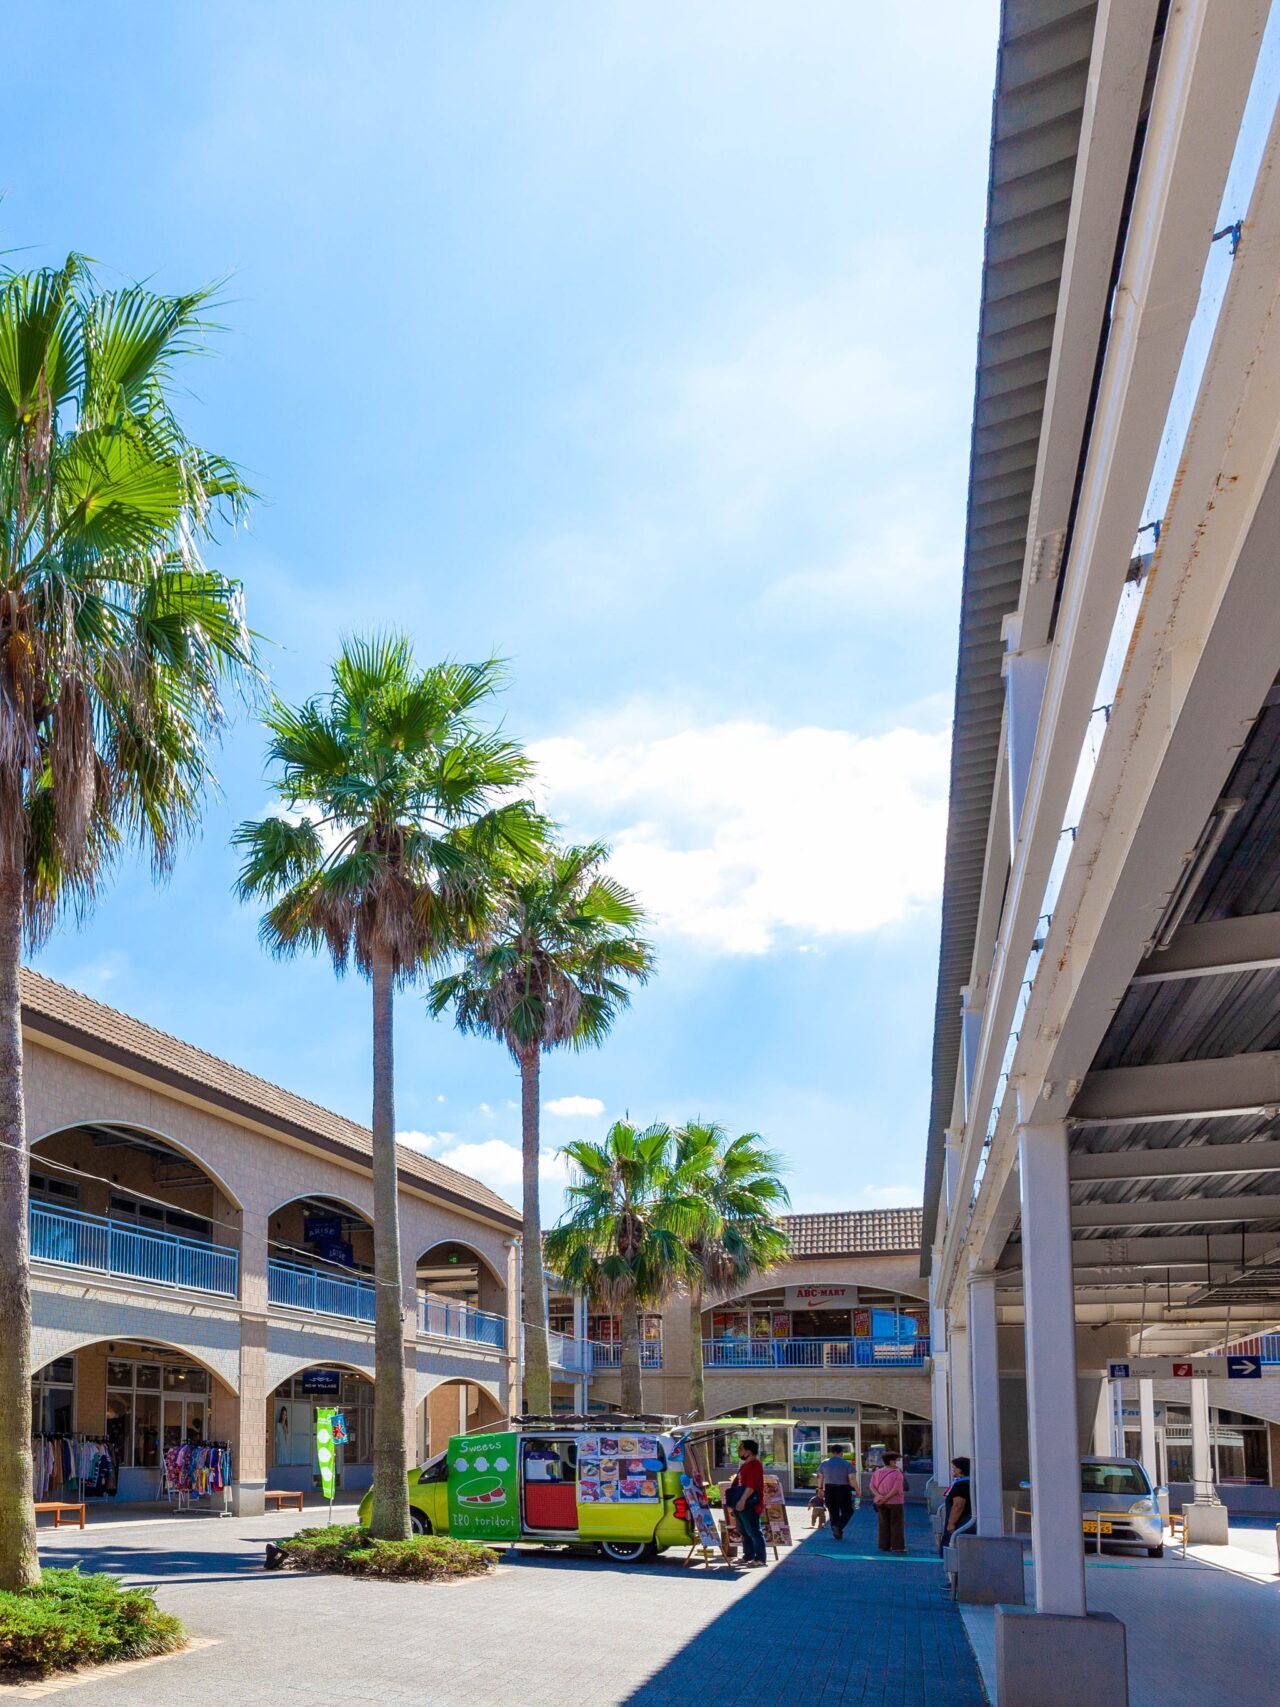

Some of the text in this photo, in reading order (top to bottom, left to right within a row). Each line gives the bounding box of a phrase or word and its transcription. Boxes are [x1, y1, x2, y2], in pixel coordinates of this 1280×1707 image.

[308, 1226, 335, 1237] ARISE
[796, 1289, 846, 1298] ABC-MART
[823, 1406, 856, 1414] Family
[459, 1441, 502, 1454] Sweets
[475, 1514, 514, 1527] toridori
